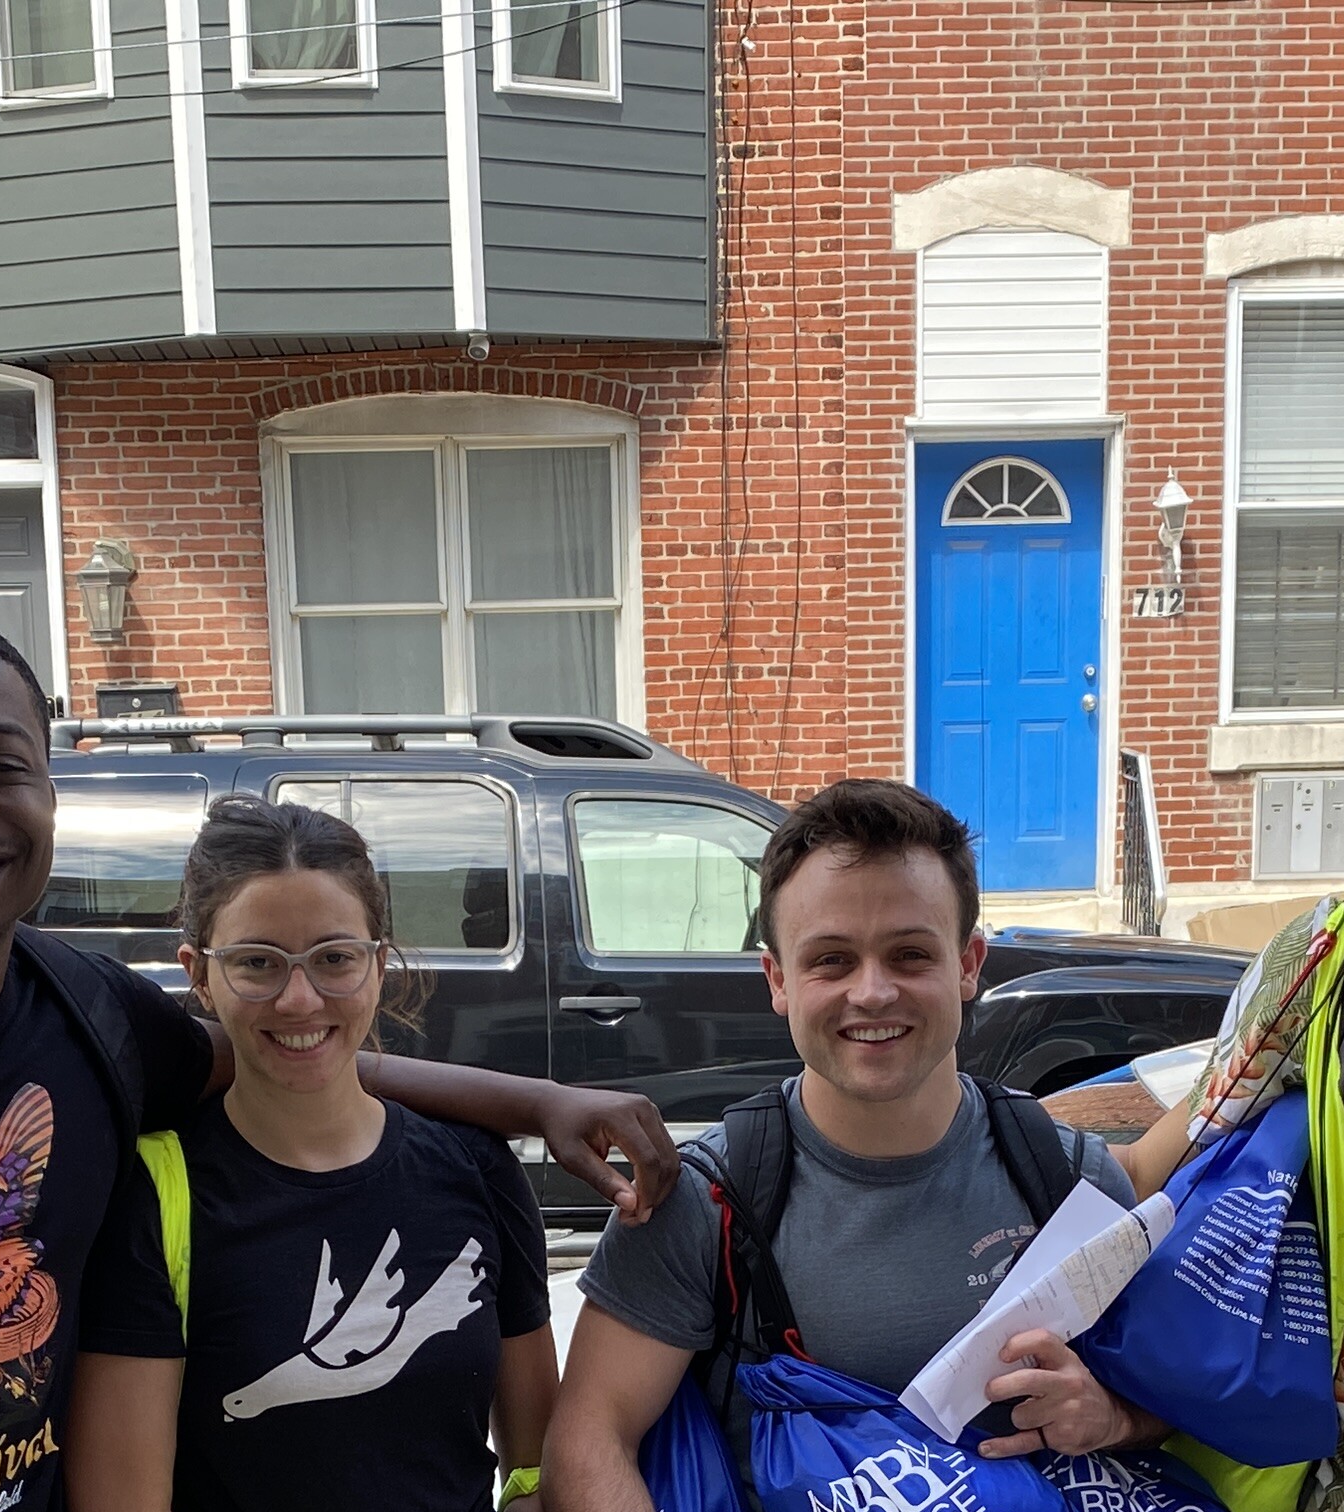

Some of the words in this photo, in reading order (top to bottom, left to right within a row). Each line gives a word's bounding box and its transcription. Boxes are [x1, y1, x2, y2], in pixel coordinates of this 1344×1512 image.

[1136, 588, 1183, 616] 712
[1211, 1205, 1235, 1220] Trevor
[1234, 1216, 1261, 1233] Lifeline
[1216, 1197, 1247, 1216] National
[1246, 1212, 1269, 1227] Suicid
[1198, 1225, 1236, 1249] Substance
[1234, 1244, 1256, 1261] Abuse
[1204, 1214, 1237, 1234] National
[1235, 1229, 1257, 1248] Eating
[1180, 1257, 1208, 1280] Veterans
[1185, 1247, 1206, 1263] Rape,
[1204, 1258, 1226, 1278] Abuse,
[1225, 1274, 1241, 1285] and
[1238, 1278, 1260, 1292] Incest
[1192, 1235, 1224, 1256] National
[1221, 1252, 1247, 1273] Alliance
[1173, 1268, 1202, 1292] Veterans
[1200, 1288, 1217, 1305] Crisis
[1216, 1299, 1232, 1313] Text
